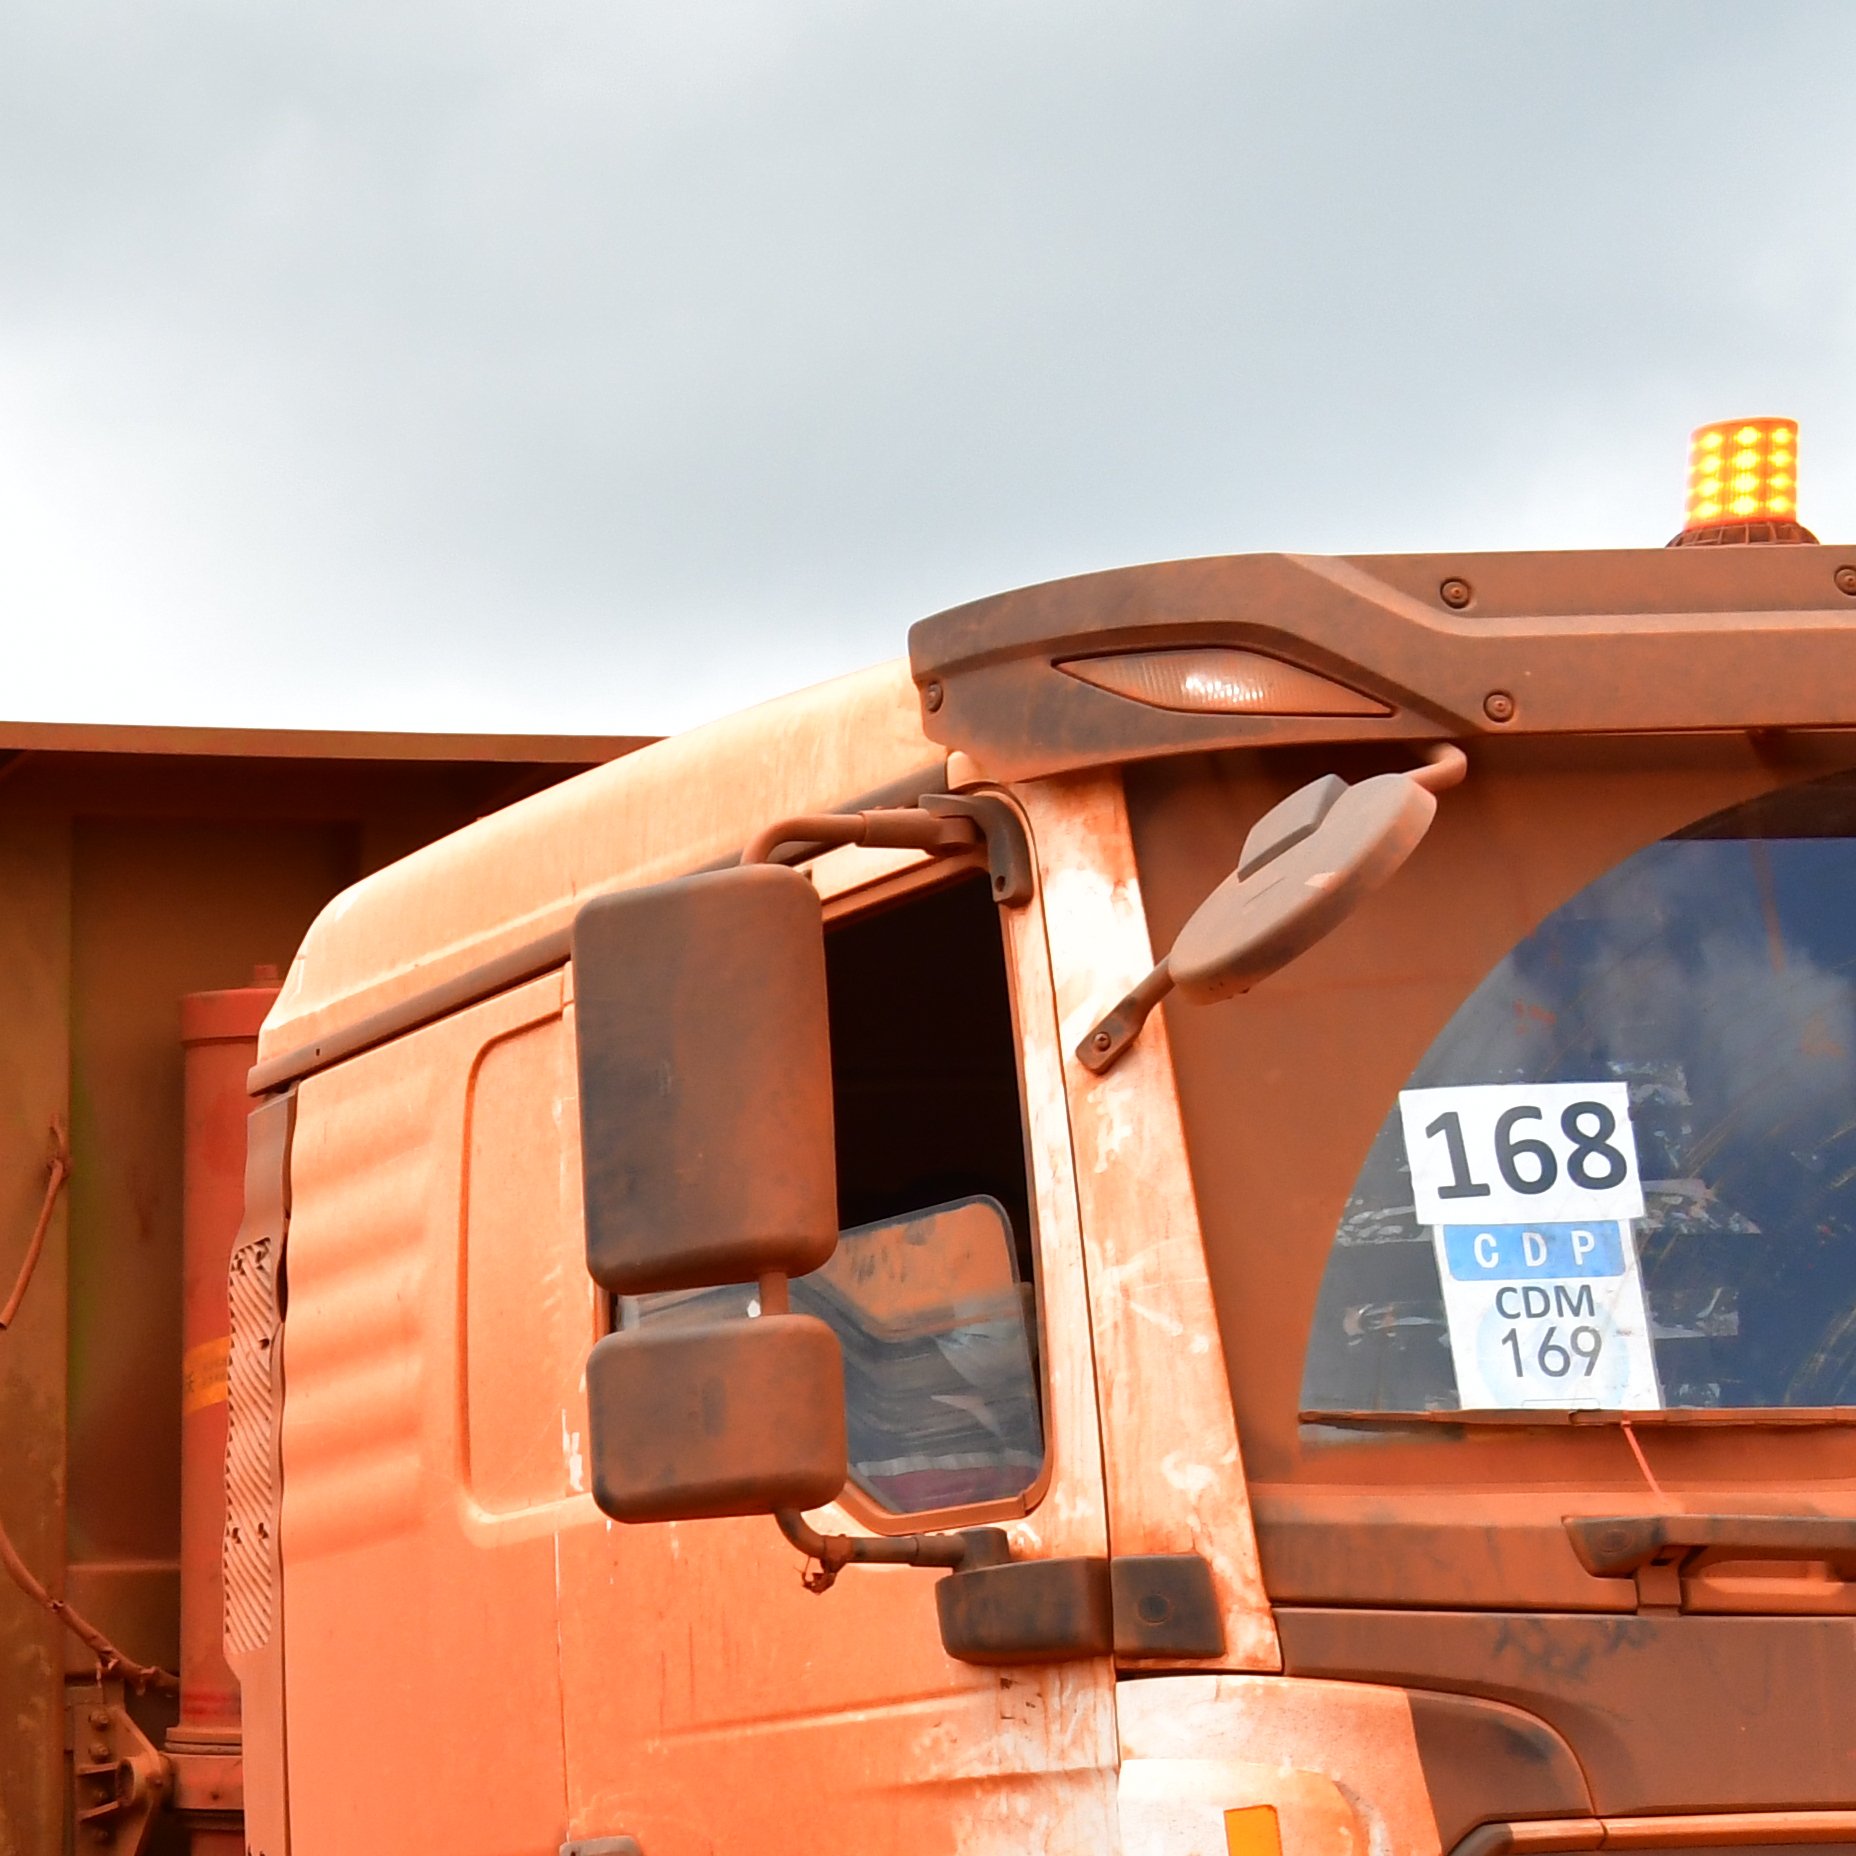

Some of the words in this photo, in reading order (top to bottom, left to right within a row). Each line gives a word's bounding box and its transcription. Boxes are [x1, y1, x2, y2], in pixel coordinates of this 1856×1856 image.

[1424, 1100, 1628, 1200] 168
[1494, 1284, 1596, 1320] CDM
[1500, 1324, 1603, 1378] 169
